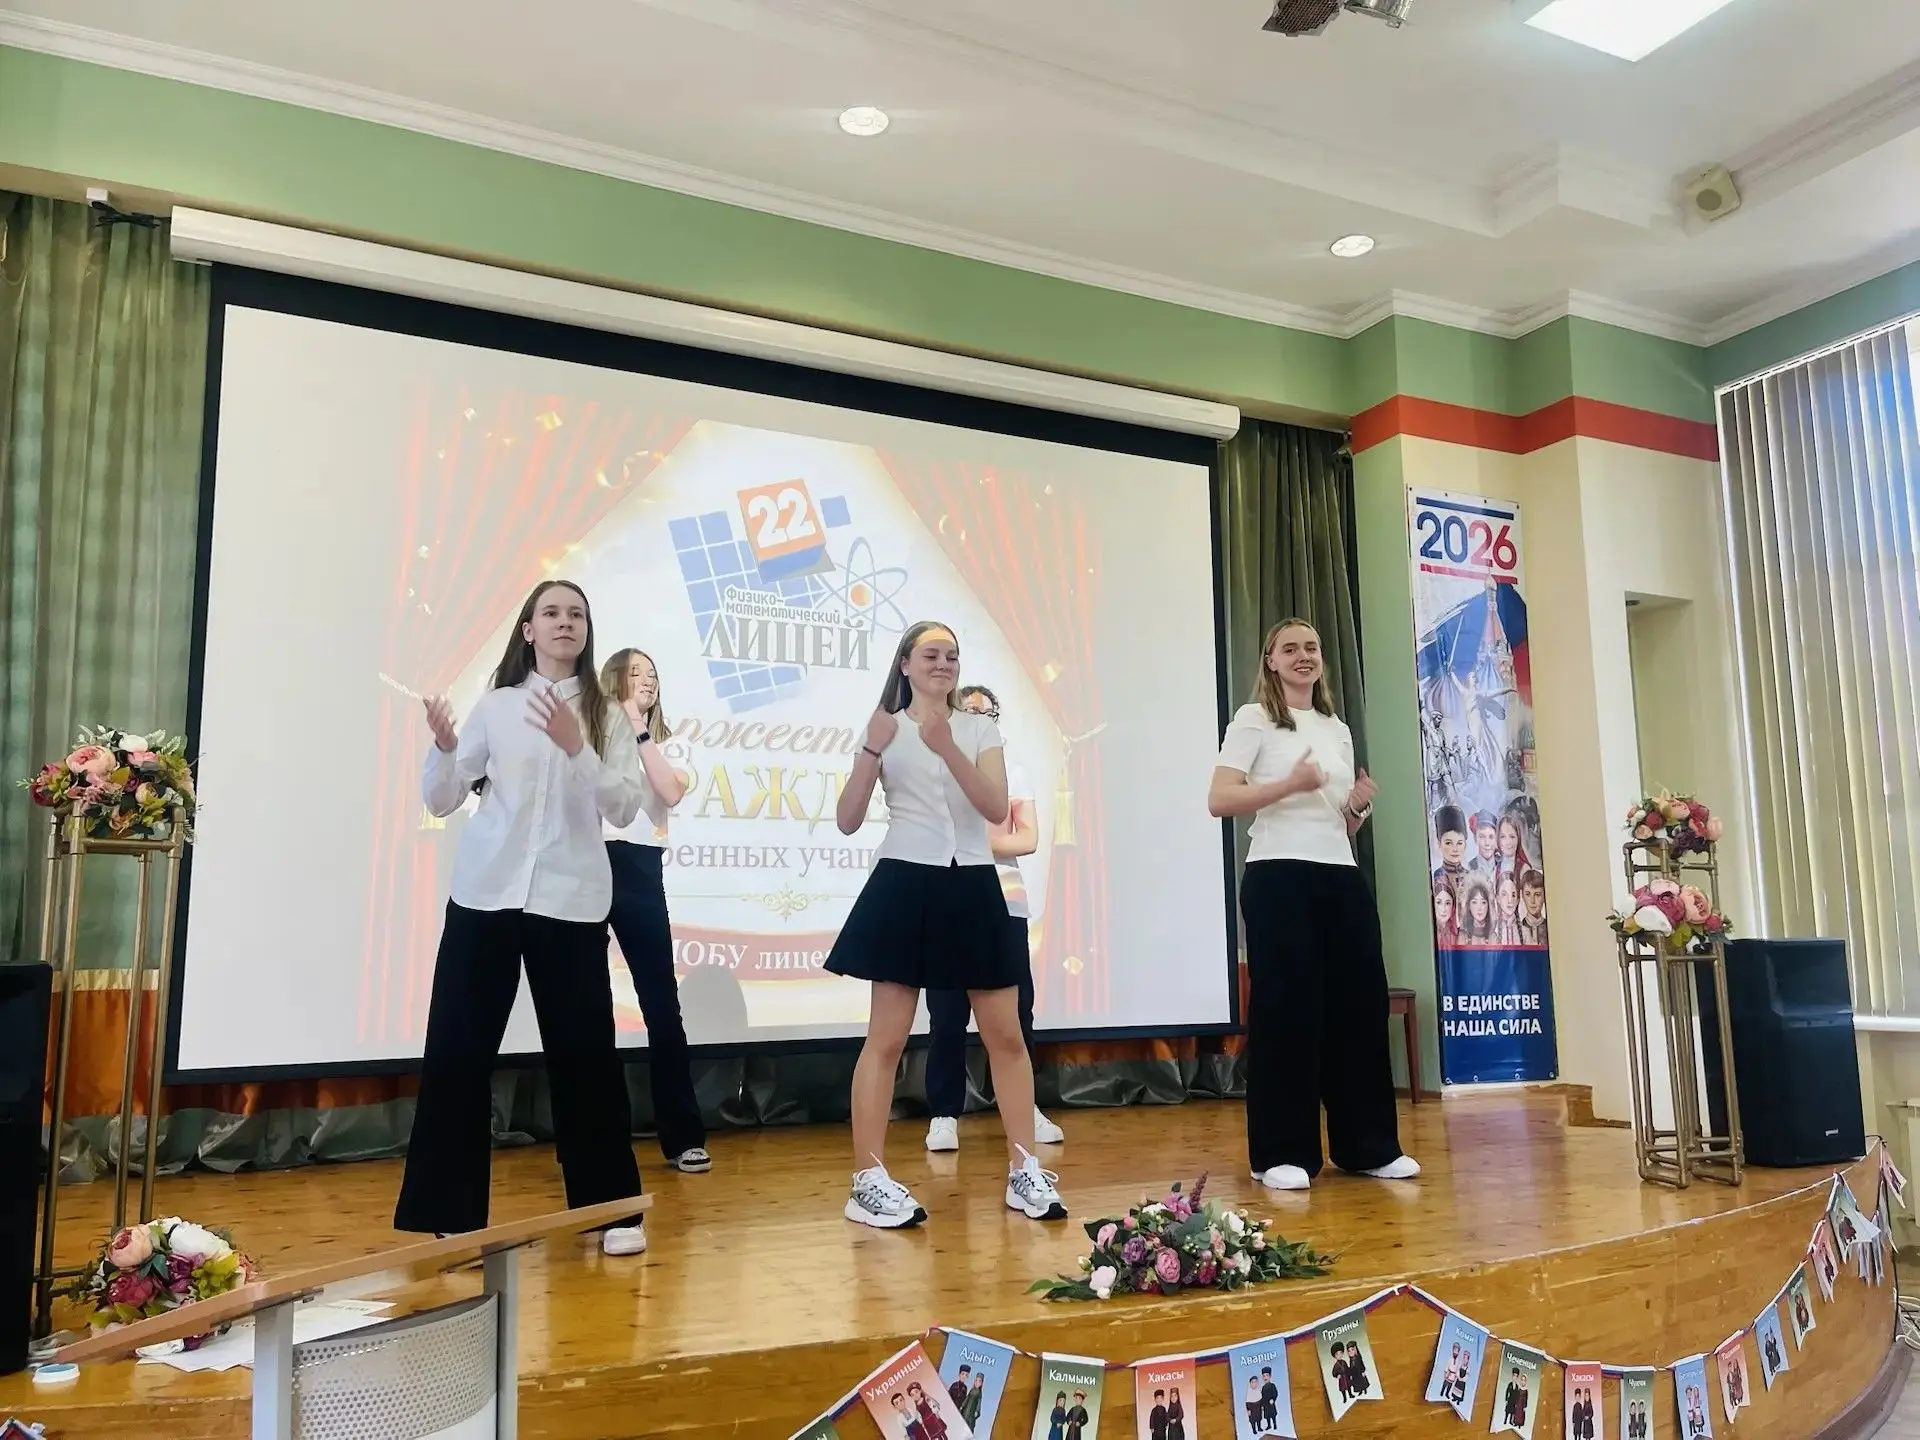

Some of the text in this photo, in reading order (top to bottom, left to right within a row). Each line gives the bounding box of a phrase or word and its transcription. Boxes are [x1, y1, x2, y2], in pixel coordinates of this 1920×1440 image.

[748, 487, 816, 548] 22
[1416, 511, 1518, 571] 2026
[726, 587, 784, 606] Физико-
[726, 601, 841, 625] математический
[701, 612, 871, 676] ЛИЦЕЙ
[755, 949, 832, 972] лице
[1443, 994, 1540, 1015] В ЕДИНСТВЕ
[1444, 1018, 1542, 1037] НАША СИЛА
[1322, 1319, 1360, 1341] Грузины
[959, 1346, 996, 1367] Адыги
[1240, 1350, 1278, 1367] Аварцы
[866, 1355, 924, 1401] Украинцы
[1049, 1370, 1096, 1386] Калмыки
[1148, 1371, 1184, 1384] Хакасы
